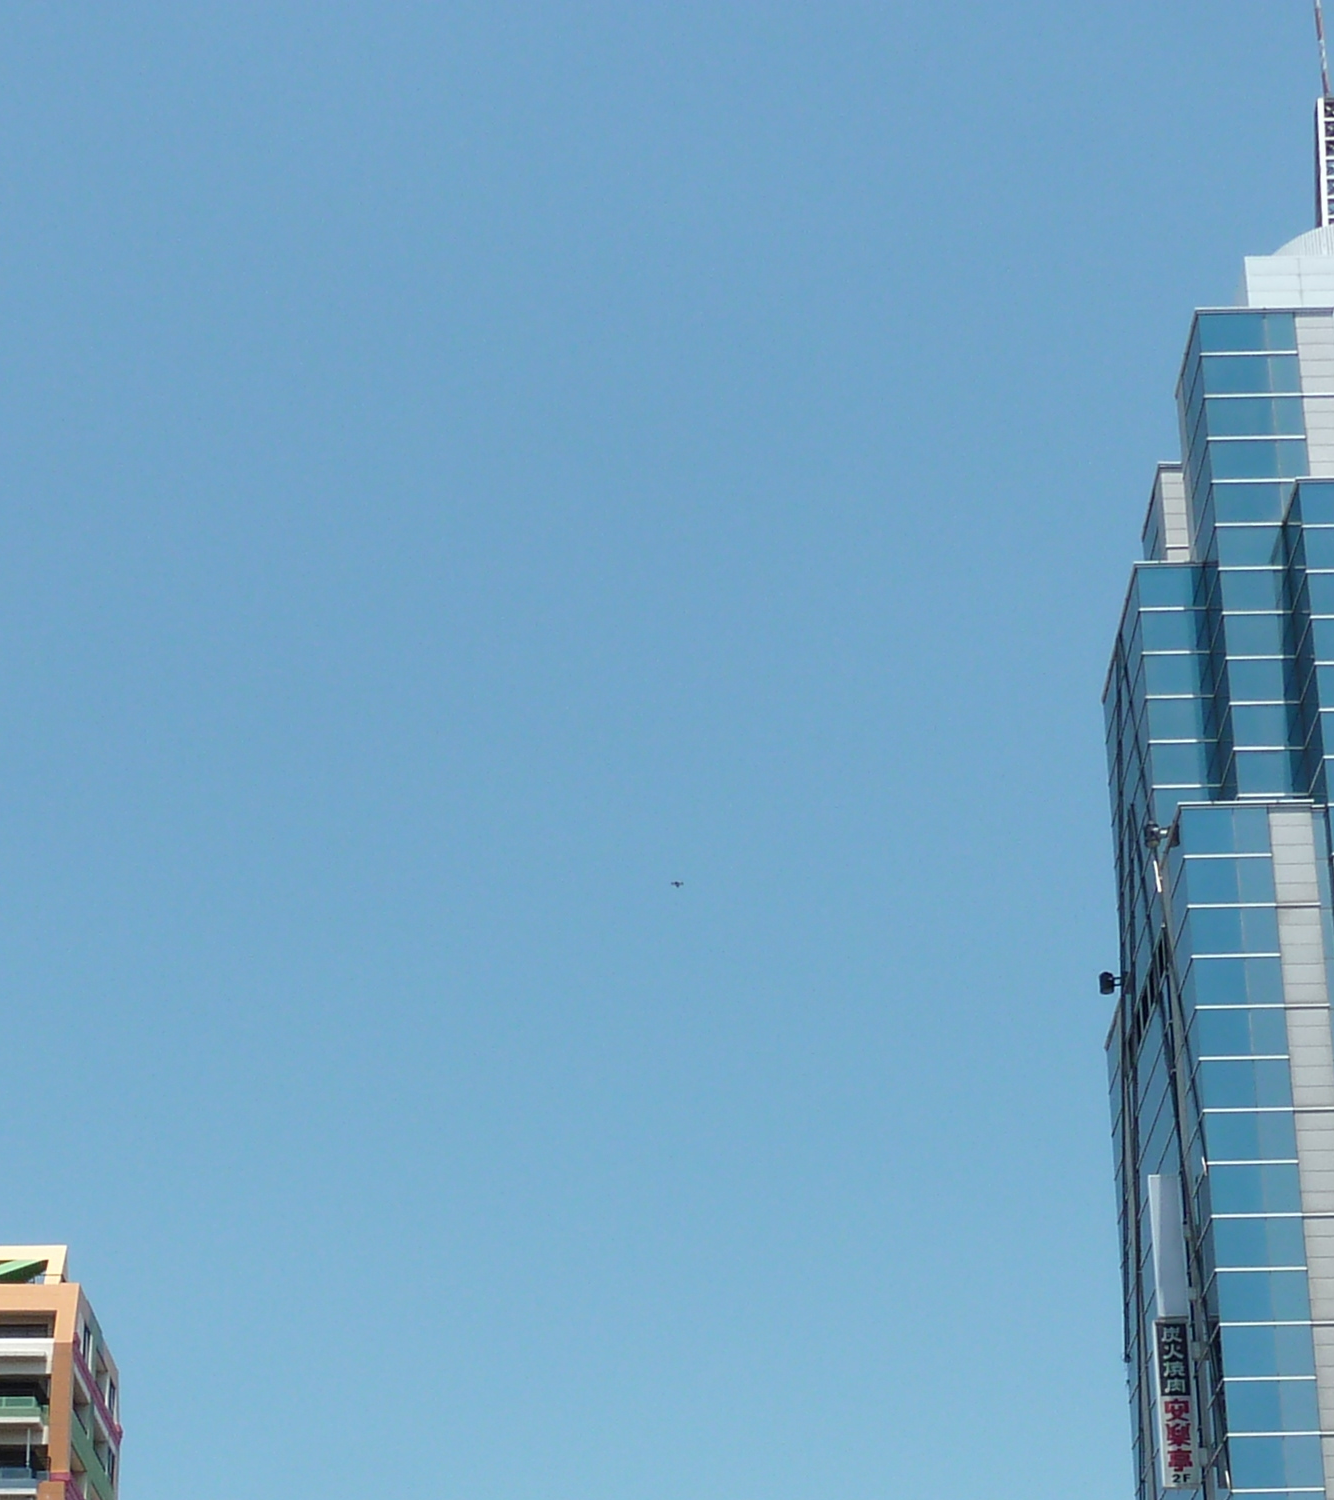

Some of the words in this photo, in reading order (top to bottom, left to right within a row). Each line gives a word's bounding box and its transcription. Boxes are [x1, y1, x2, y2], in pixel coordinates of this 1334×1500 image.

[1161, 1327, 1187, 1394] 炭火焼肉
[1164, 1399, 1194, 1472] 安楽亭
[1171, 1473, 1191, 1484] 2F
